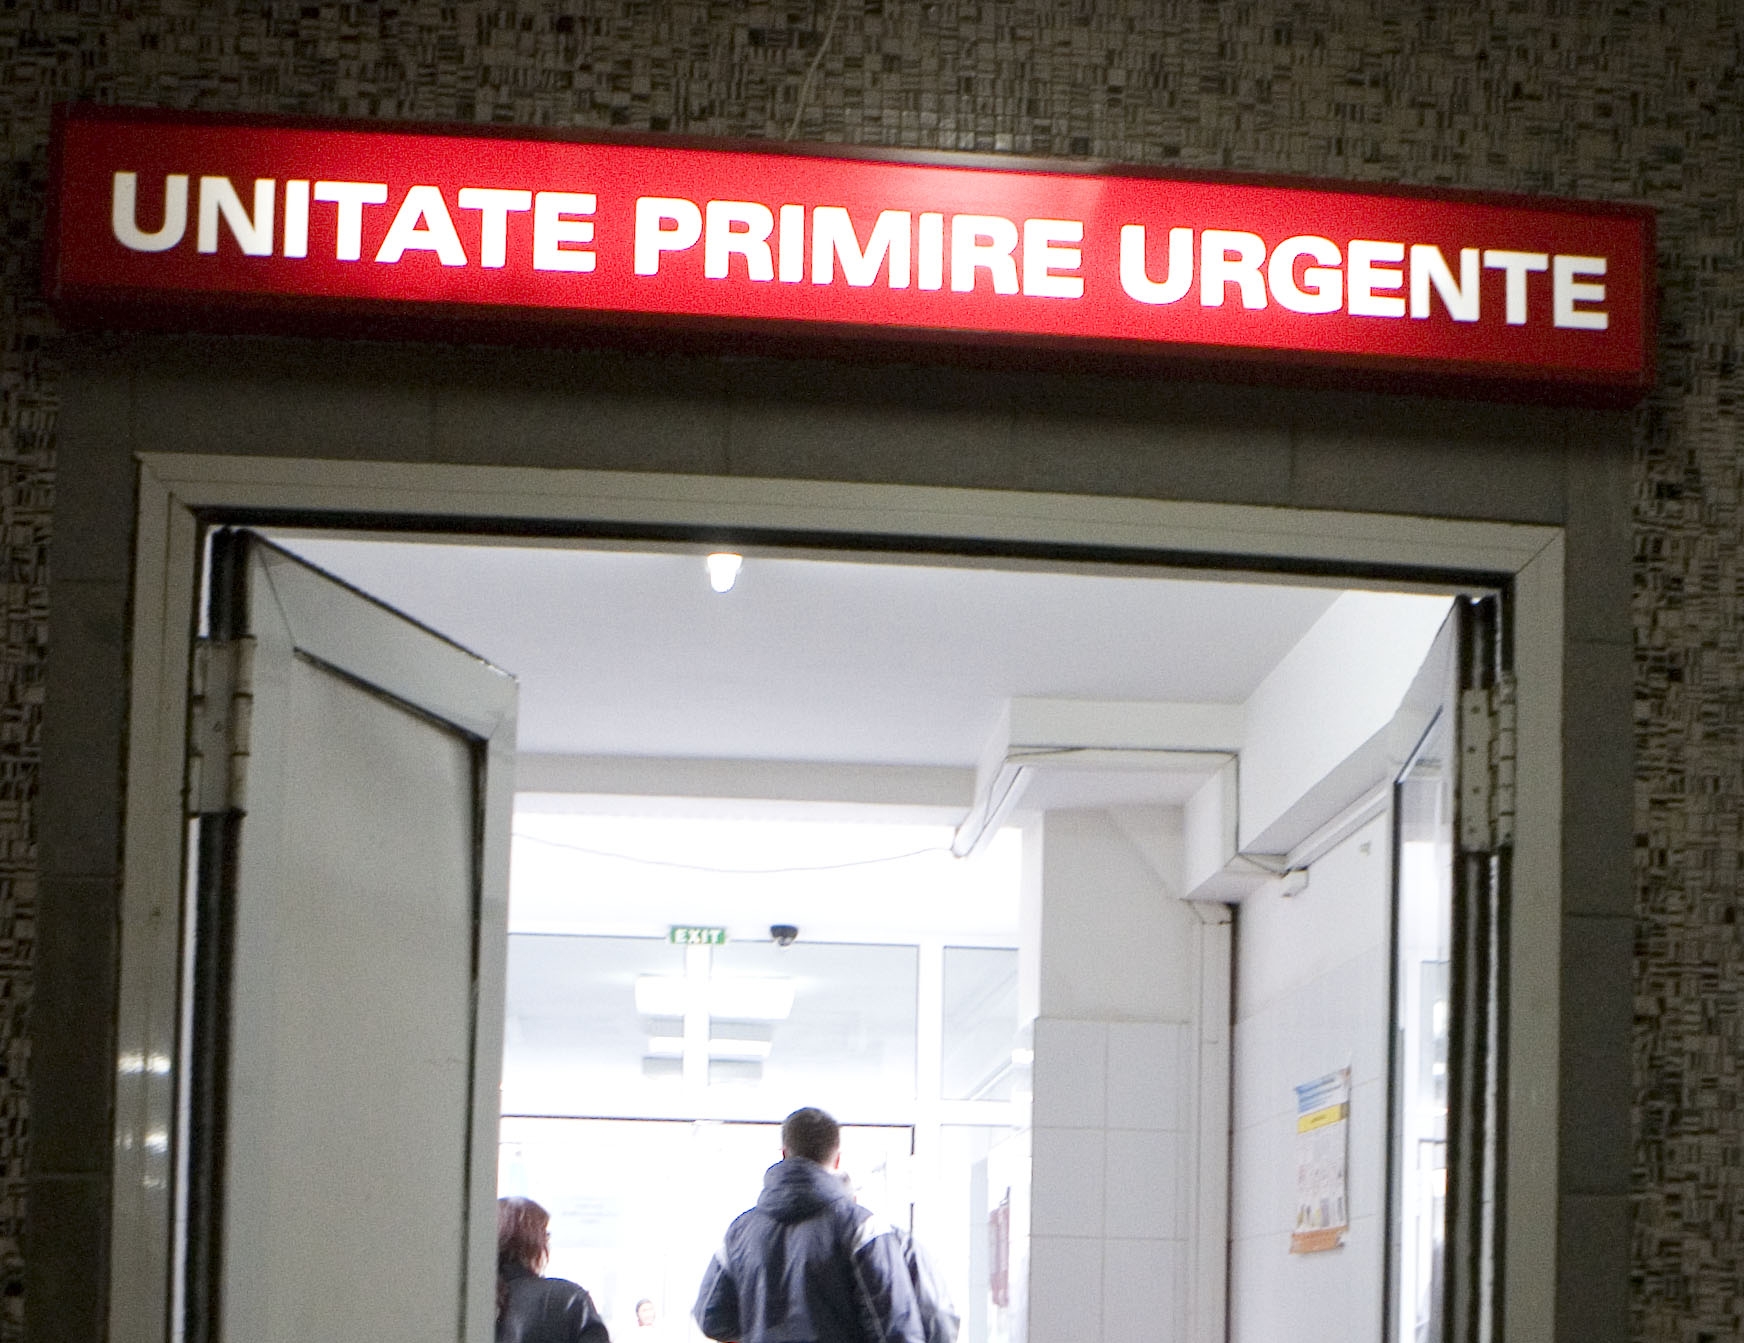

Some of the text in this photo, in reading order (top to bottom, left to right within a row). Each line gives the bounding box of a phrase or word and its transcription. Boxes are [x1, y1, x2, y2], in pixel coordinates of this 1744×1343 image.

[111, 172, 1609, 330] UNITATE PRIMIRE URGENTE
[674, 928, 721, 943] EXIT
